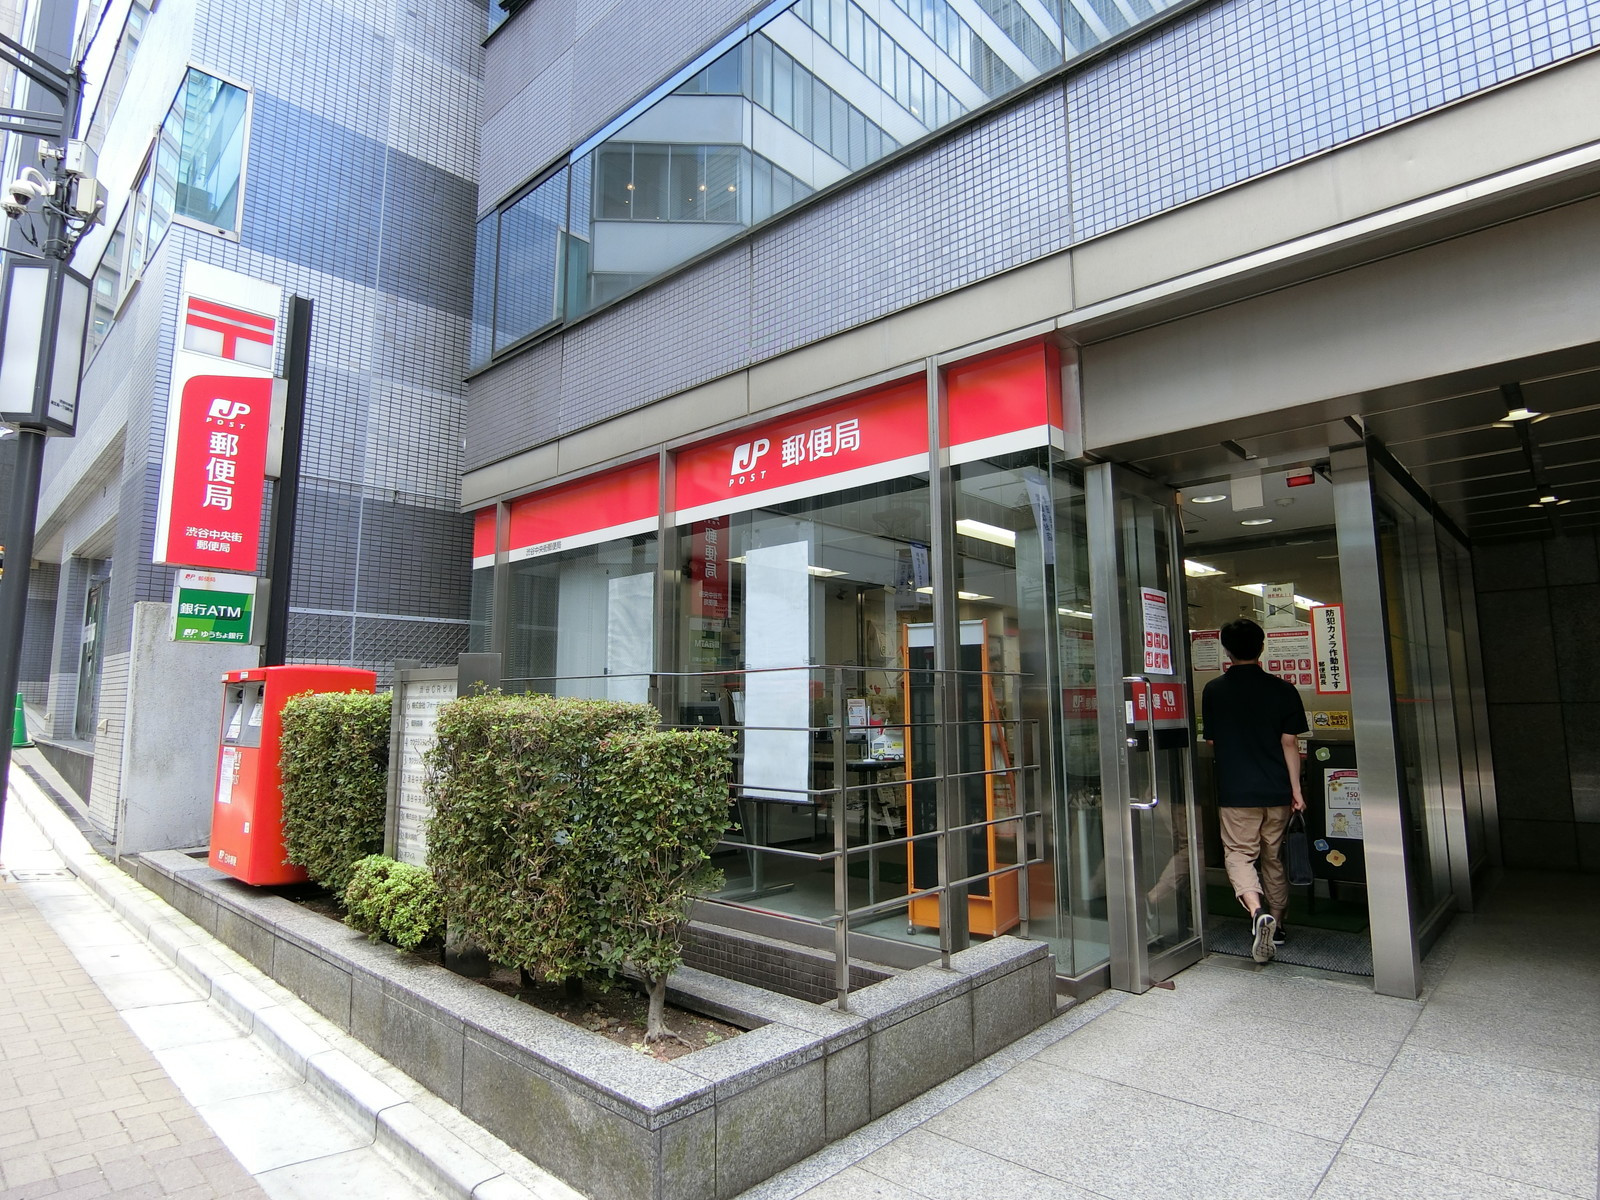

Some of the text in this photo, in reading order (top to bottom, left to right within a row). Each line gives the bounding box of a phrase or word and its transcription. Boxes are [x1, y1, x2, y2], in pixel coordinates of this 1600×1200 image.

[206, 417, 246, 430] POST
[781, 418, 860, 468] 郵便局
[202, 431, 239, 511] 郵便局
[728, 470, 767, 488] POST
[185, 526, 243, 543] 渋谷中央街
[196, 539, 231, 553] 郵便局
[179, 602, 242, 618] 銀行ATM
[200, 630, 244, 640] ゆうちょ銀行
[1325, 609, 1341, 689] 防犯カメラ作動中です
[1318, 661, 1327, 686] 郵便局長
